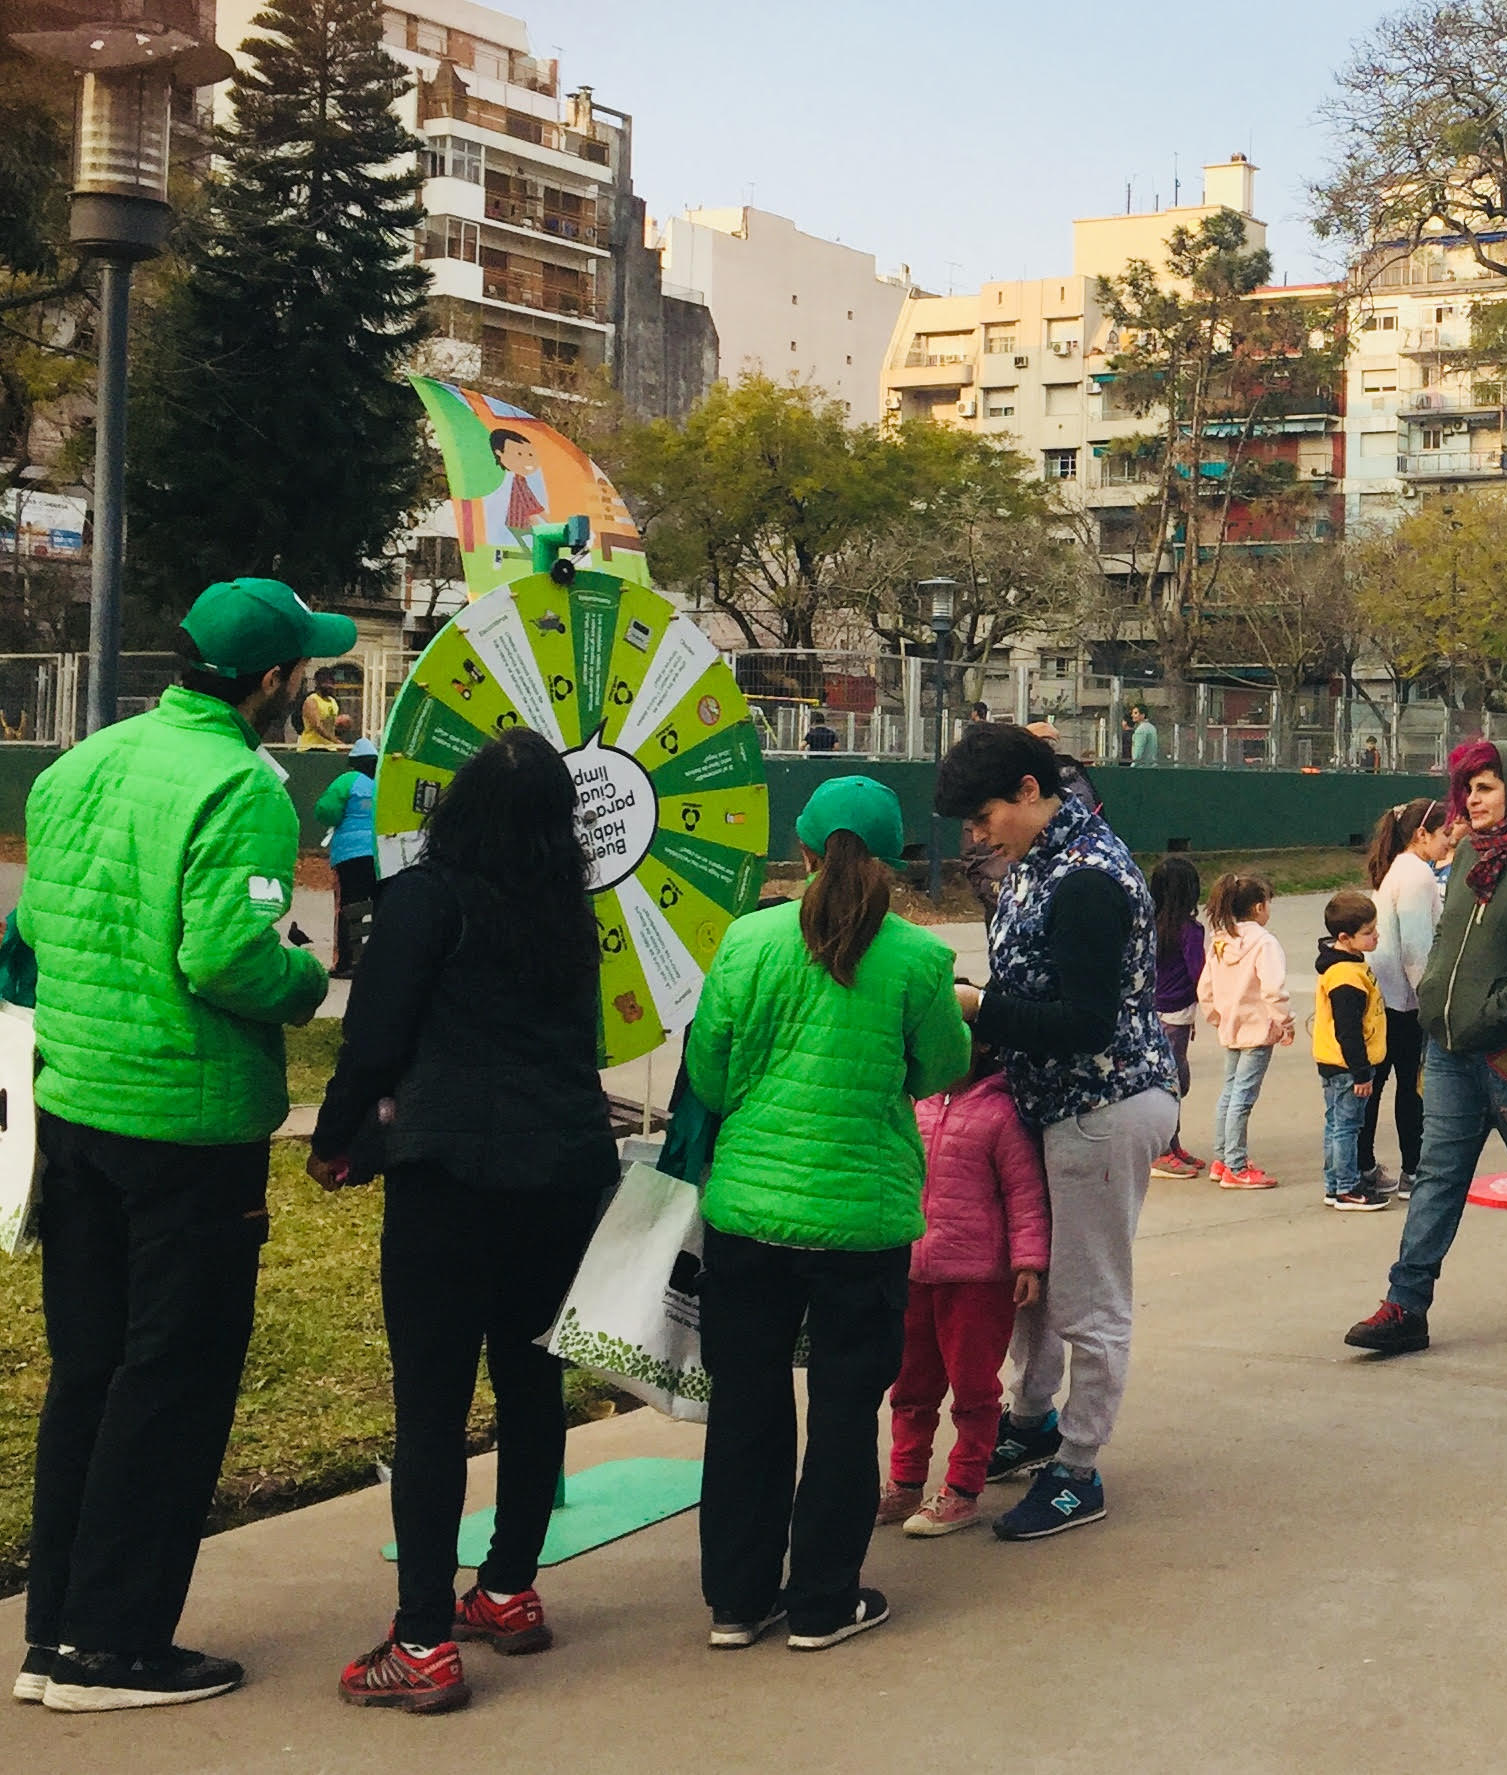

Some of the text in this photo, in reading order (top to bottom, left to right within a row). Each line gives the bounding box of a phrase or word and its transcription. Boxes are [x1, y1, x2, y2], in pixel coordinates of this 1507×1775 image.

[574, 765, 609, 787] limp
[596, 790, 636, 817] para
[248, 876, 284, 902] BA
[669, 1249, 702, 1298] B
[1048, 1488, 1082, 1517] N
